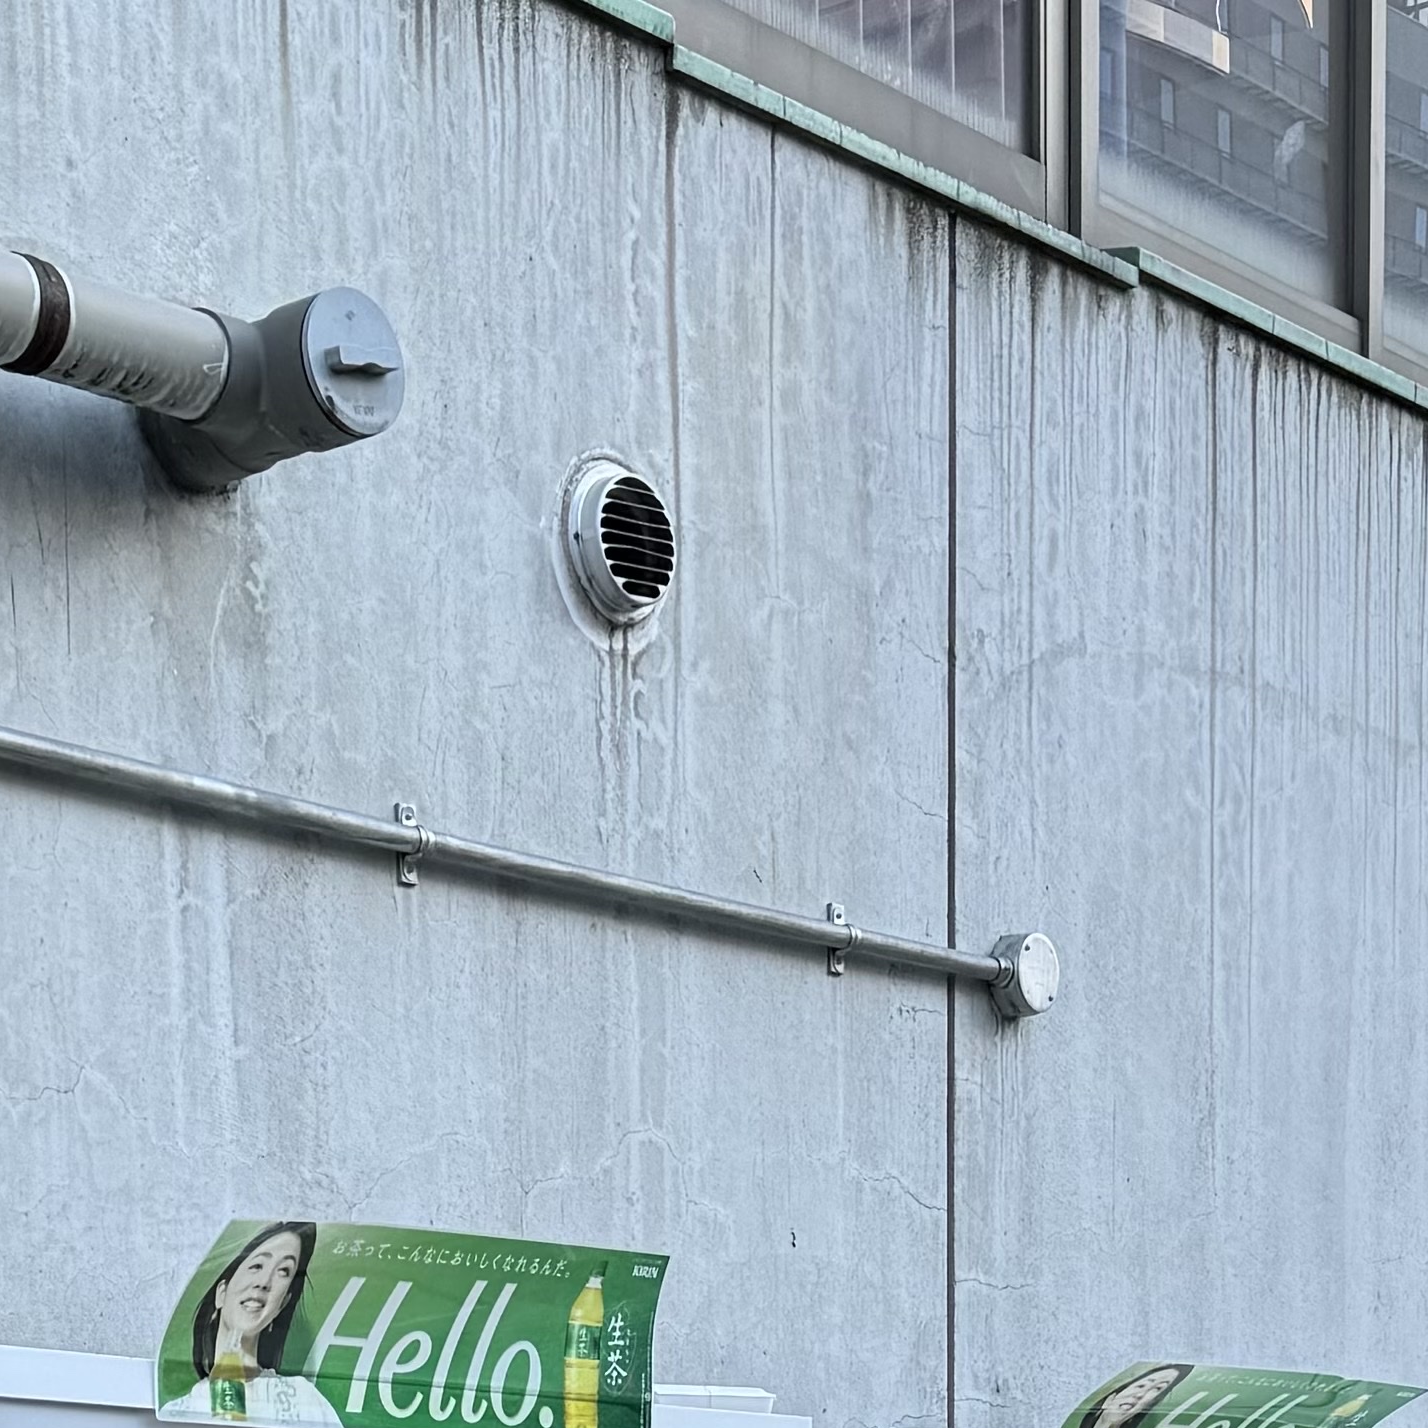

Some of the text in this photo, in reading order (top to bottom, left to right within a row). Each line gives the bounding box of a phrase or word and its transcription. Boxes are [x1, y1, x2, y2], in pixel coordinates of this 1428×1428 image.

[331, 1239, 571, 1279] お茶って、こんなにおいしくなれるんだ。
[632, 1263, 659, 1278] KIRIN
[606, 1316, 629, 1385] 生茶
